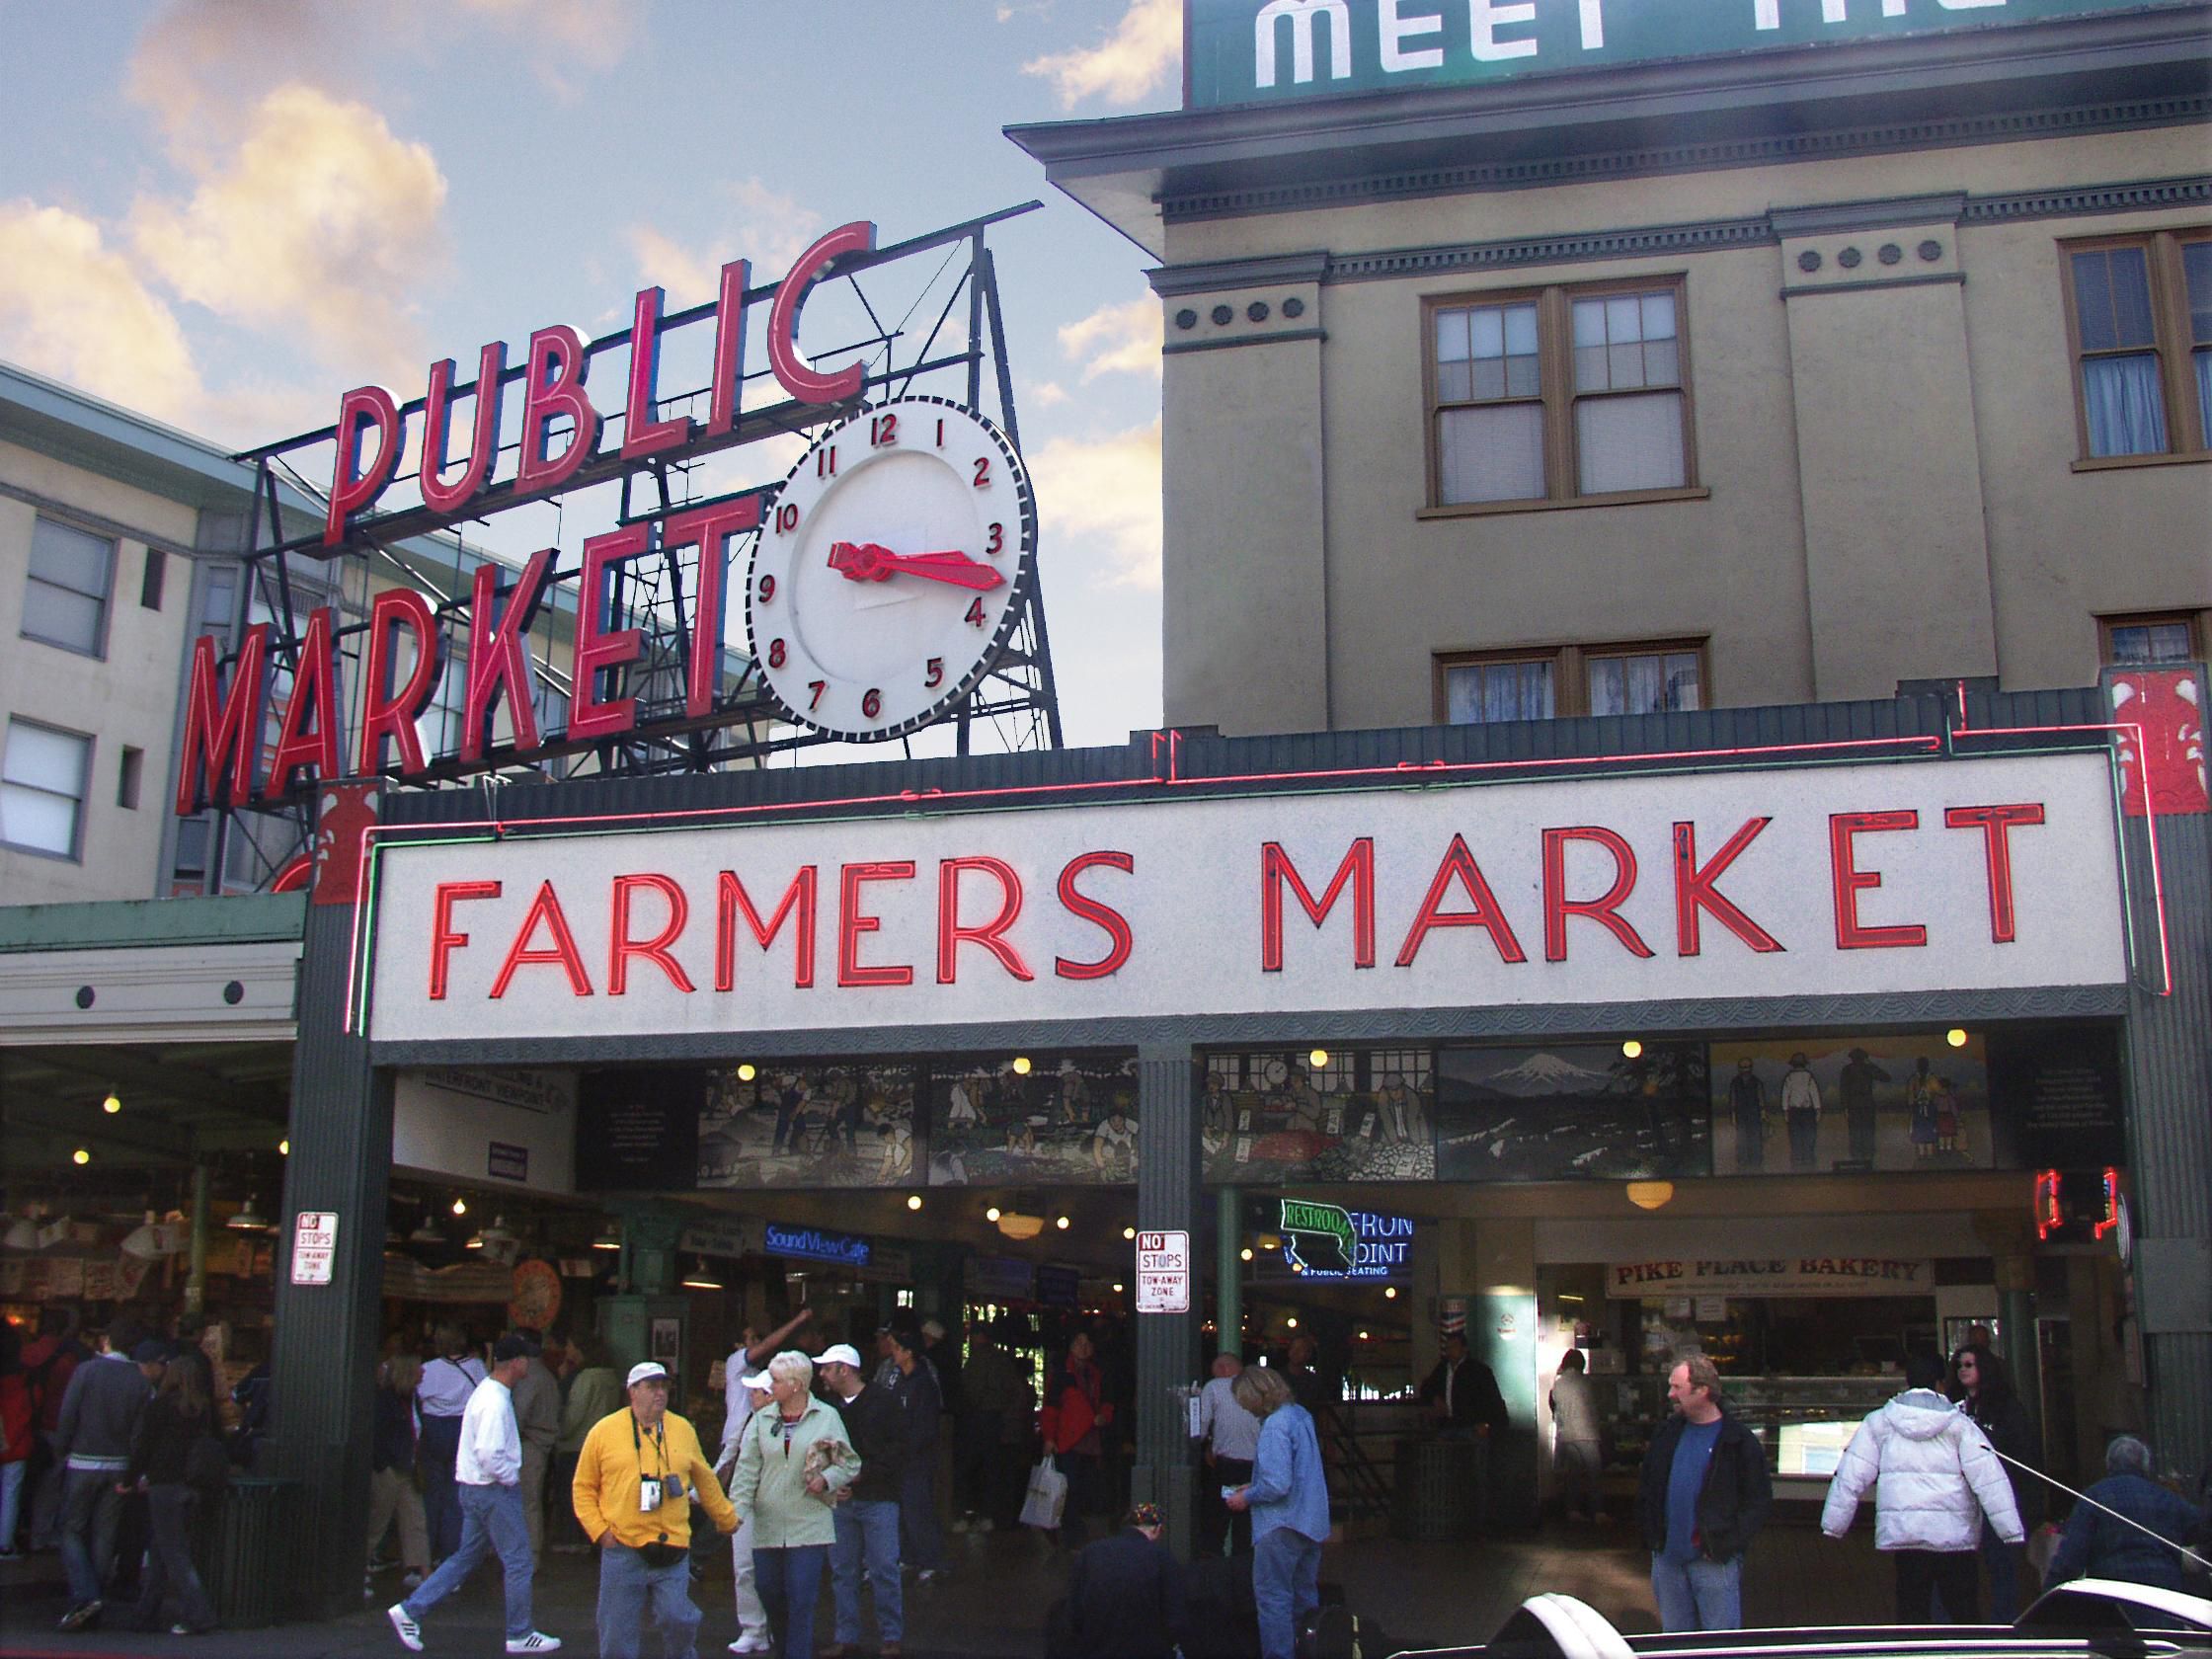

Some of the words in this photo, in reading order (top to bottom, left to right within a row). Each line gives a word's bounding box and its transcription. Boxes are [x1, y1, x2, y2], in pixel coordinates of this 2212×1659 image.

[323, 219, 877, 547] PUBLIC
[870, 413, 898, 447] 12
[935, 418, 945, 448] 1
[817, 444, 837, 479] 11
[973, 457, 990, 488] 2
[775, 503, 799, 535] 10
[986, 522, 1003, 555] 3
[758, 574, 776, 604] 9
[964, 596, 987, 629] 4
[176, 494, 765, 816] MARKET
[768, 638, 786, 670] 8
[924, 657, 944, 688] 5
[808, 680, 829, 712] 7
[862, 688, 882, 719] 6
[428, 851, 1134, 999] FARMERS
[1260, 803, 2046, 973] MARKET
[301, 1216, 317, 1228] NO
[301, 1232, 331, 1244] STOPS
[1143, 1234, 1161, 1249] NO
[1143, 1254, 1182, 1268] STOPS
[1617, 1261, 1683, 1285] PIKE
[1696, 1259, 1785, 1276] PLACE
[1798, 1257, 1920, 1282] BAKERY
[1142, 1275, 1183, 1285] TOW-AWAY
[1151, 1288, 1175, 1297] ZONE
